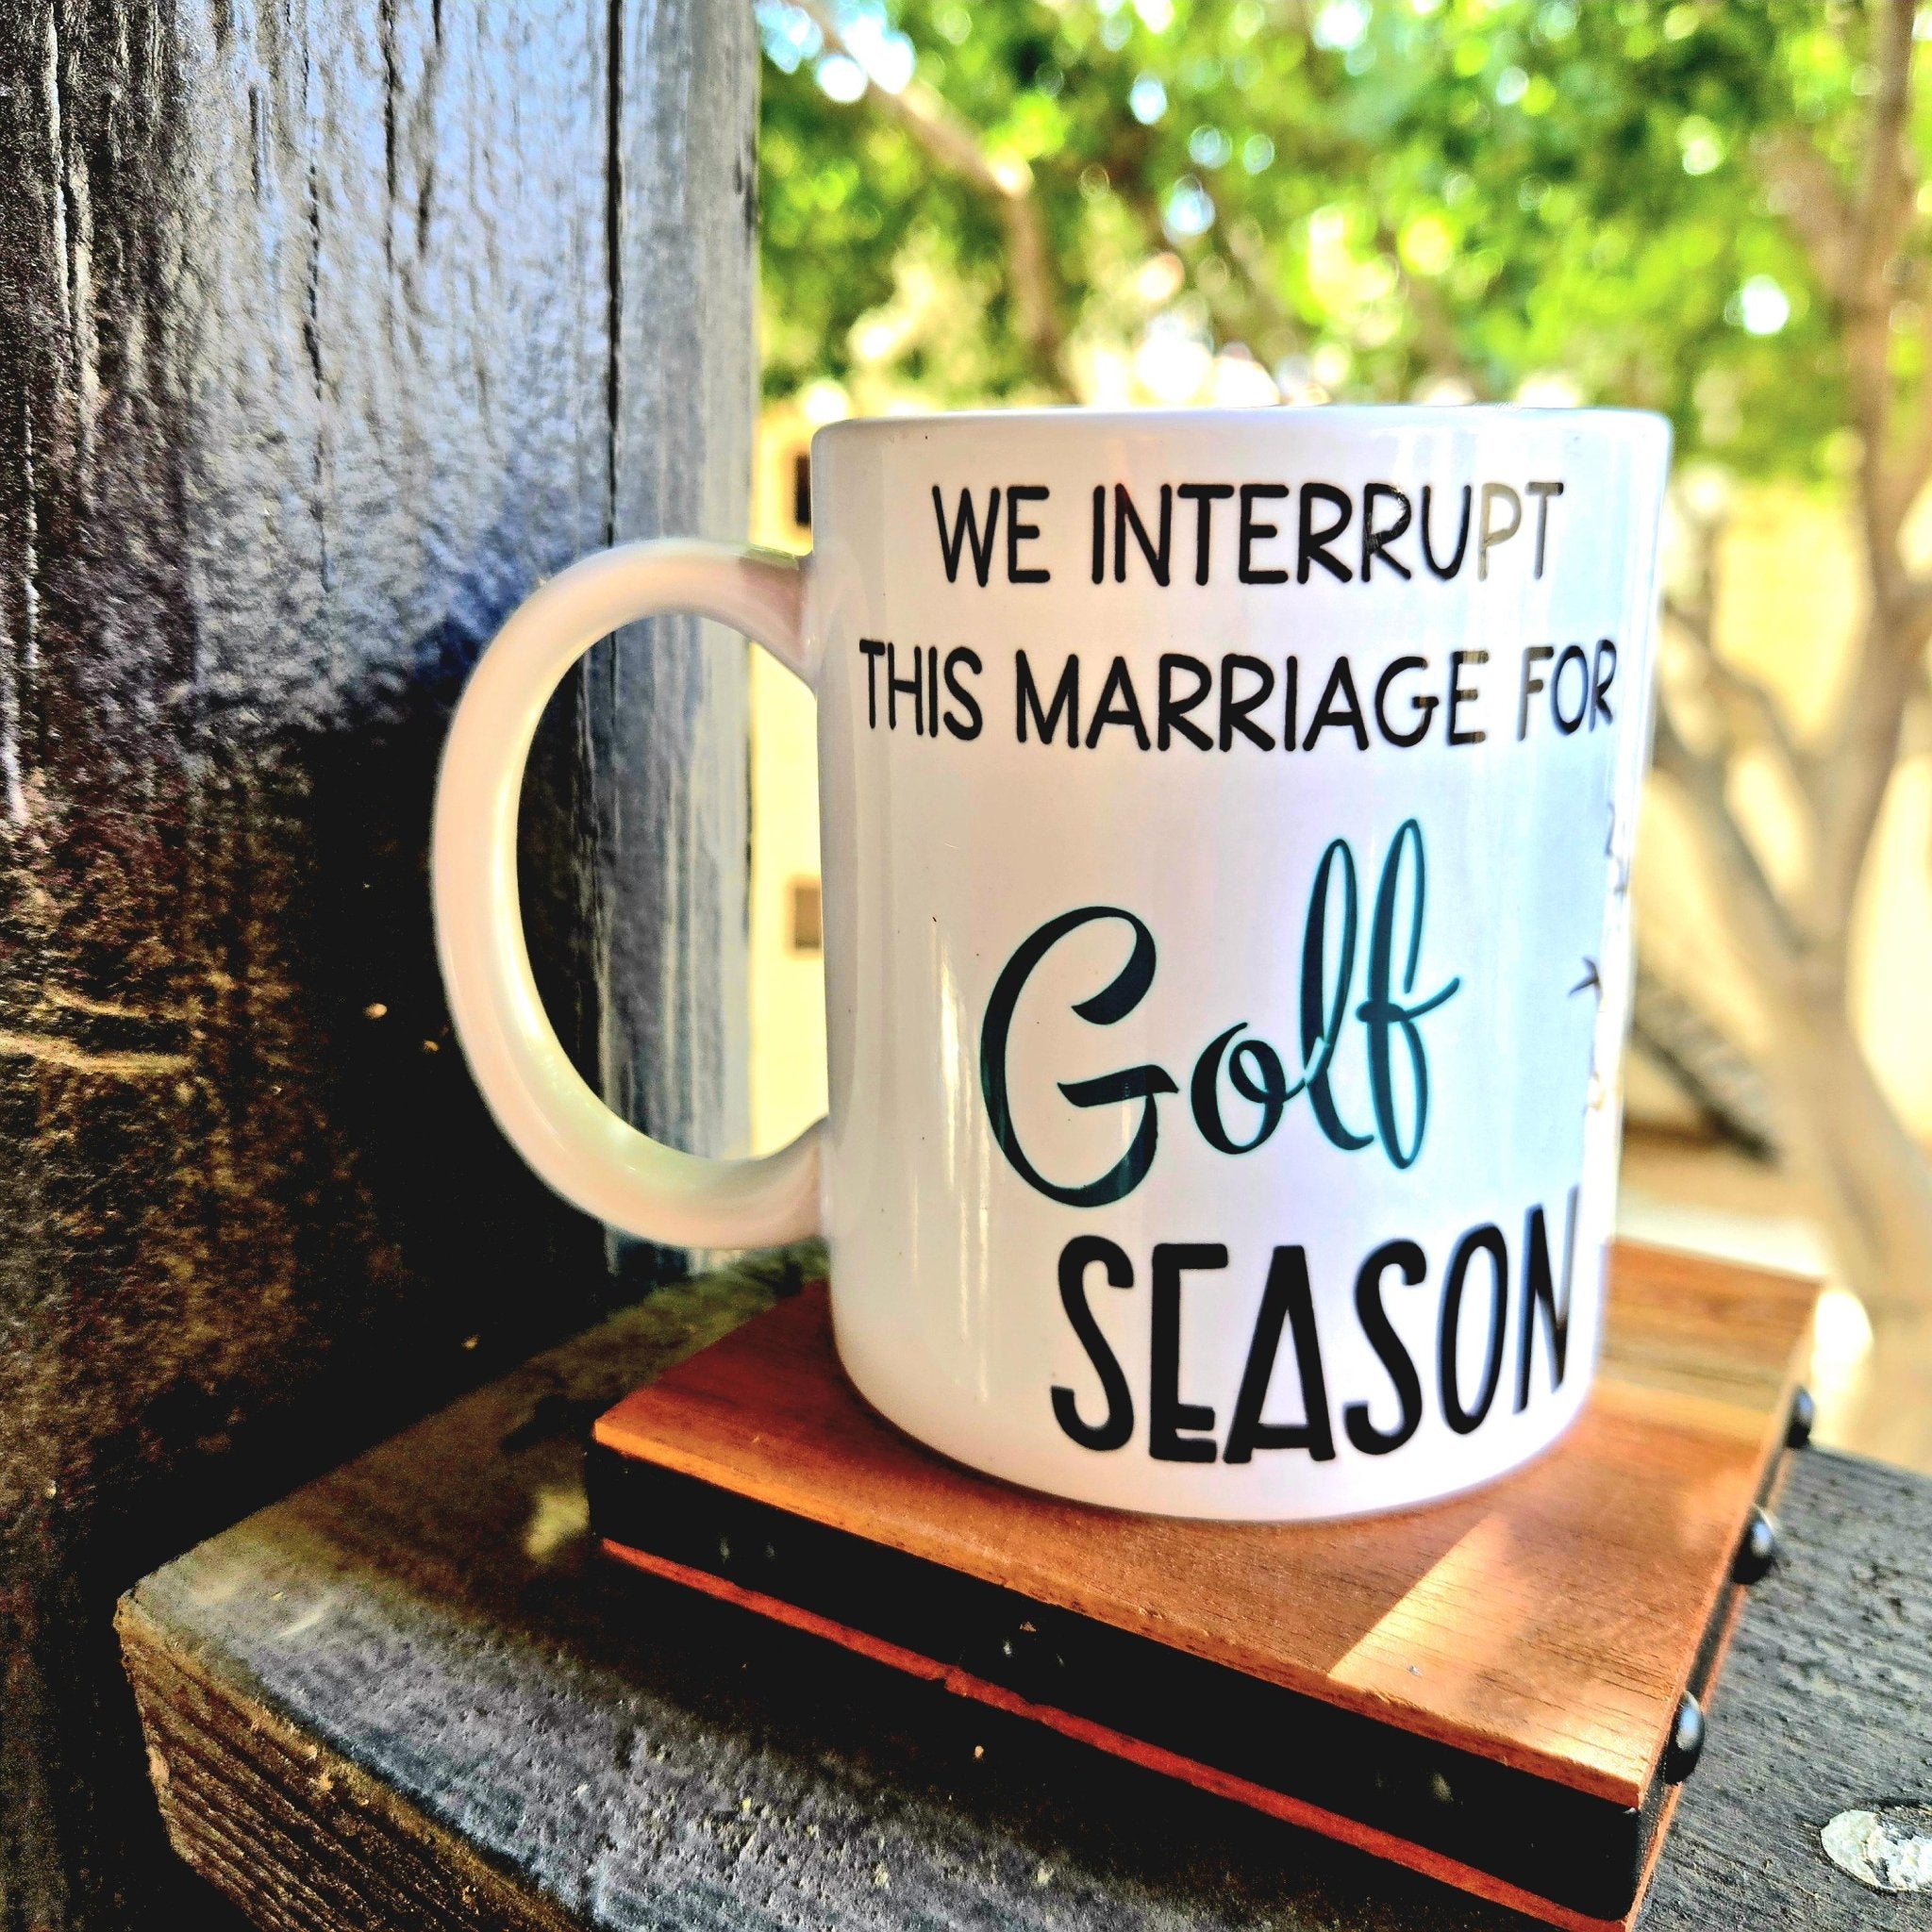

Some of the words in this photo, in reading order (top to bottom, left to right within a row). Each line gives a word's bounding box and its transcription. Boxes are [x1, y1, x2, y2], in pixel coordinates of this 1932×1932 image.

[932, 484, 1052, 587] WE
[1091, 481, 1565, 587] INTERRUPT
[858, 639, 984, 741] THIS
[1014, 648, 1488, 753] MARRIAGE
[1517, 639, 1618, 742] FOR
[979, 817, 1461, 1208] Golf
[1050, 1185, 1581, 1465] SEASON
